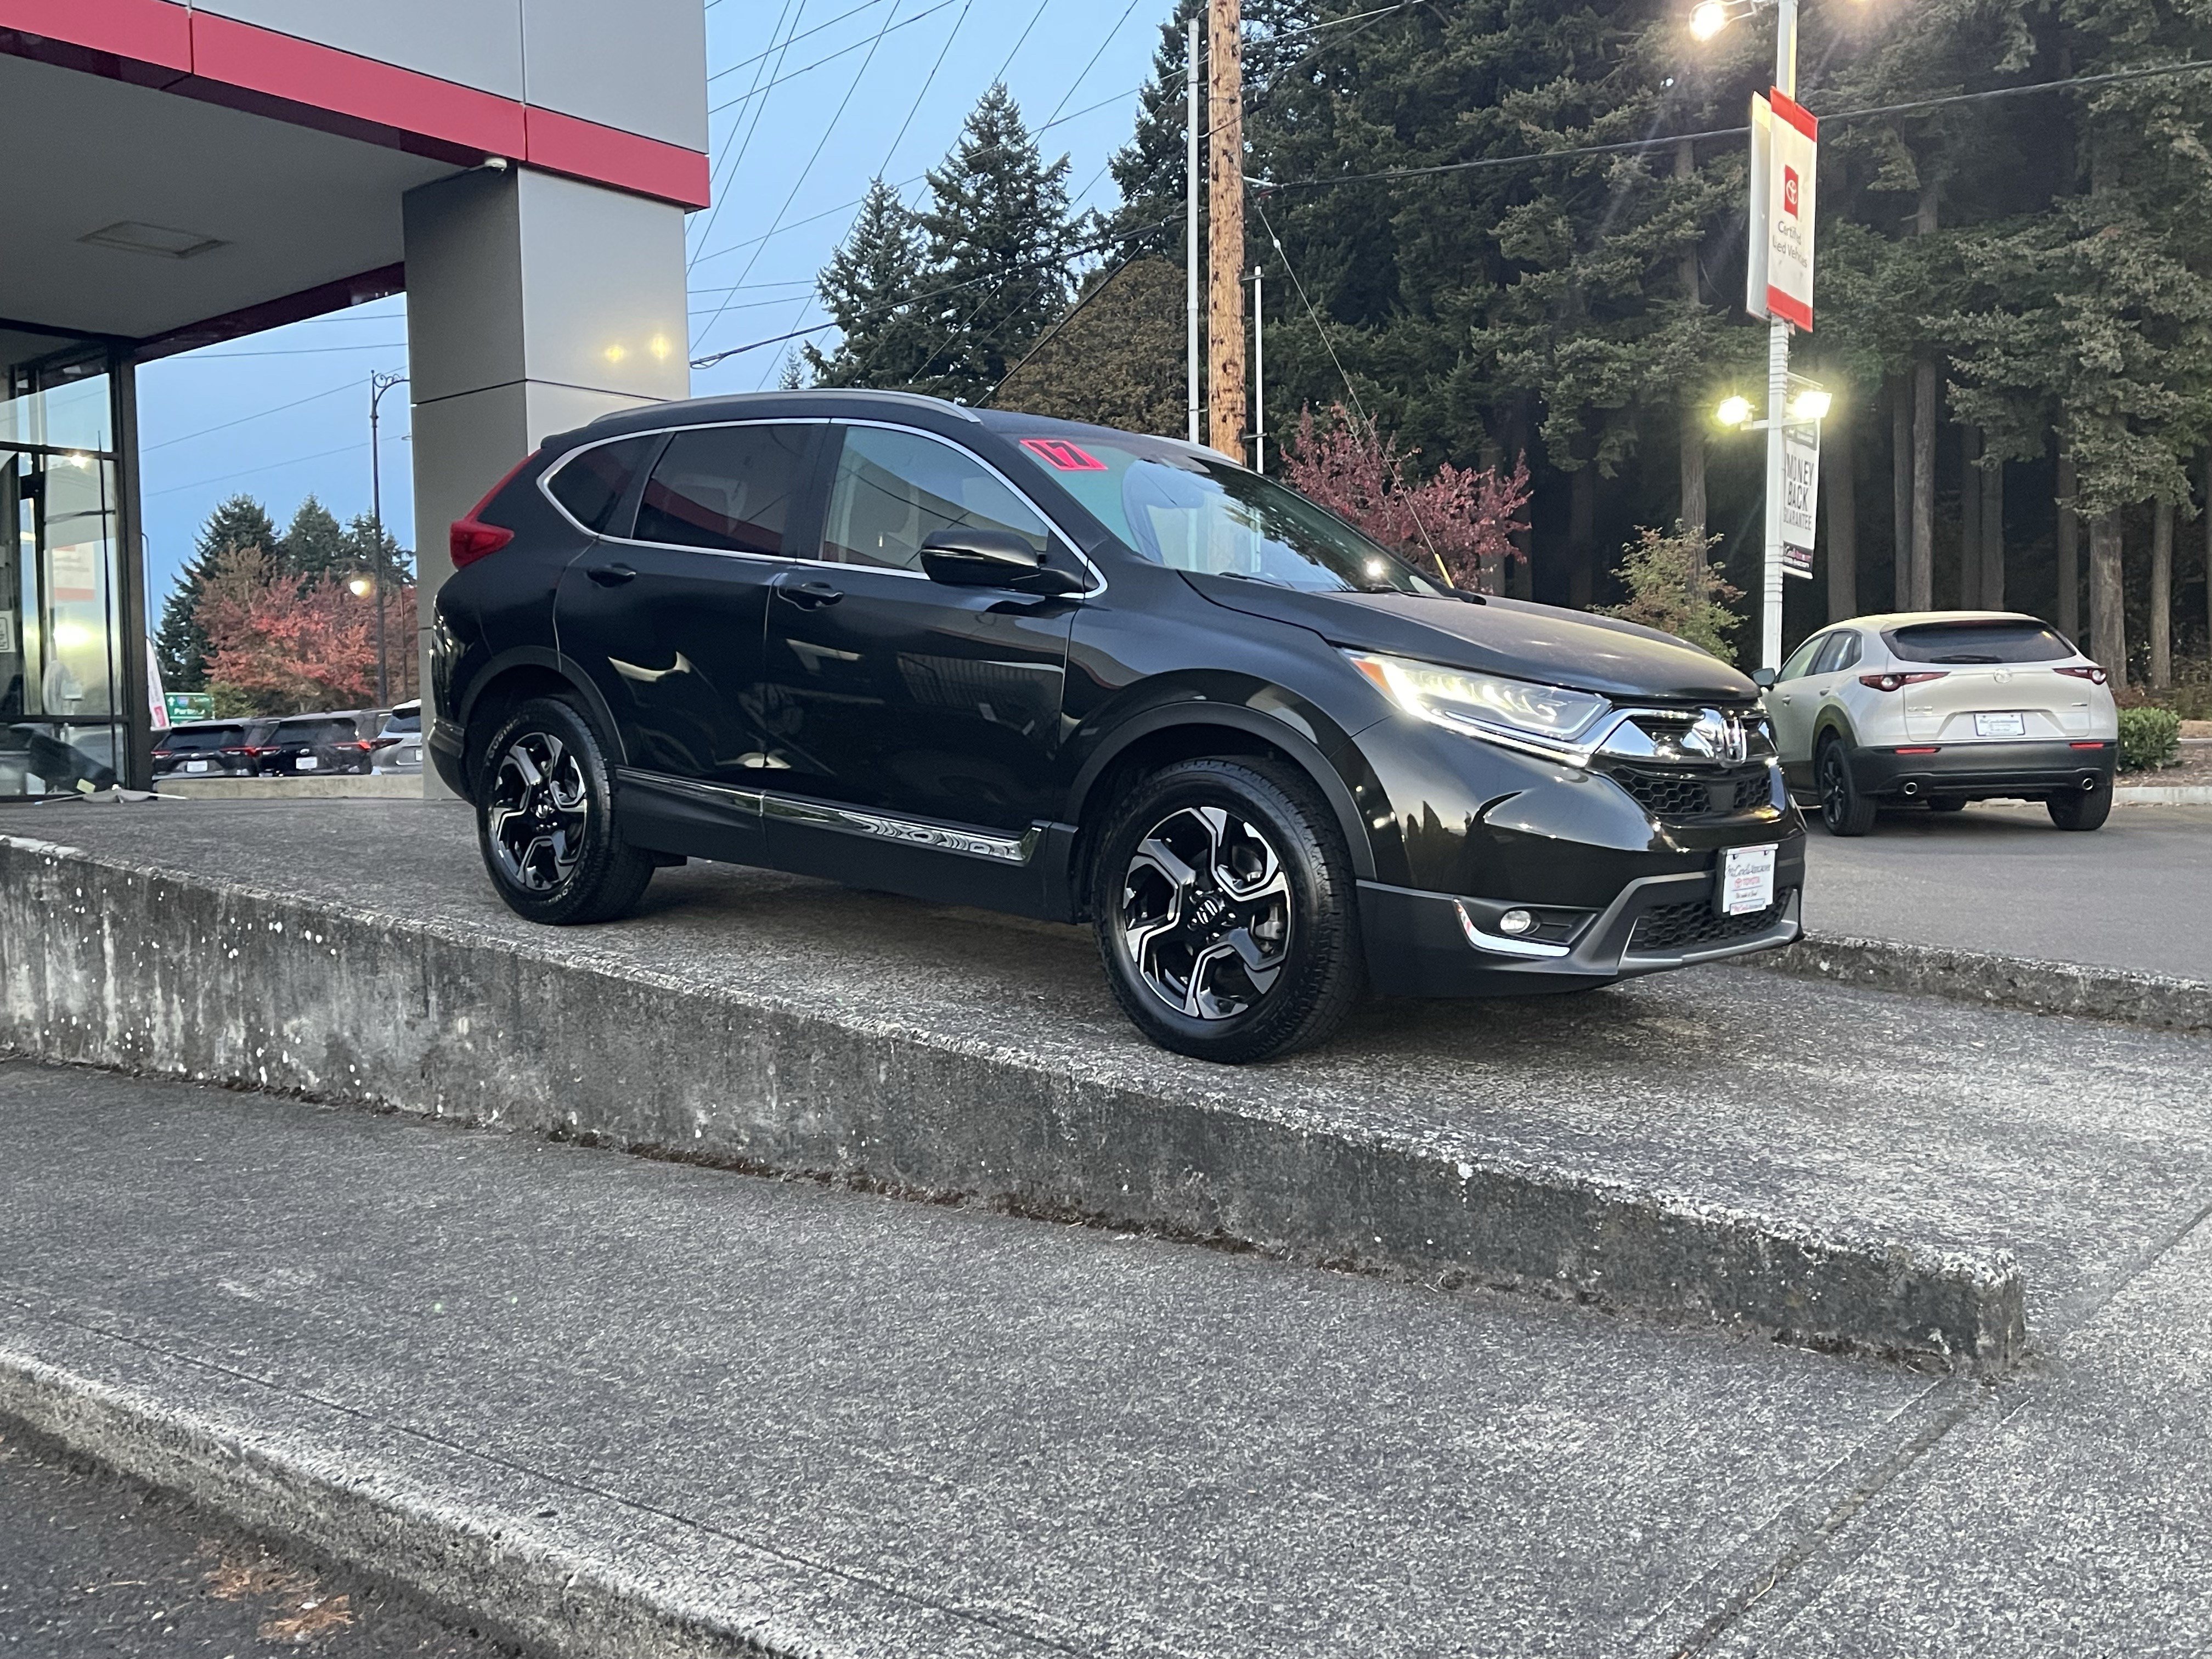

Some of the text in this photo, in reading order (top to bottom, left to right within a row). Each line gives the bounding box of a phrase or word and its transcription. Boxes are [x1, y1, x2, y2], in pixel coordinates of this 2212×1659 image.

[1028, 441, 1091, 467] 17
[1786, 453, 1814, 487] MONEY
[1787, 481, 1809, 512] BACK
